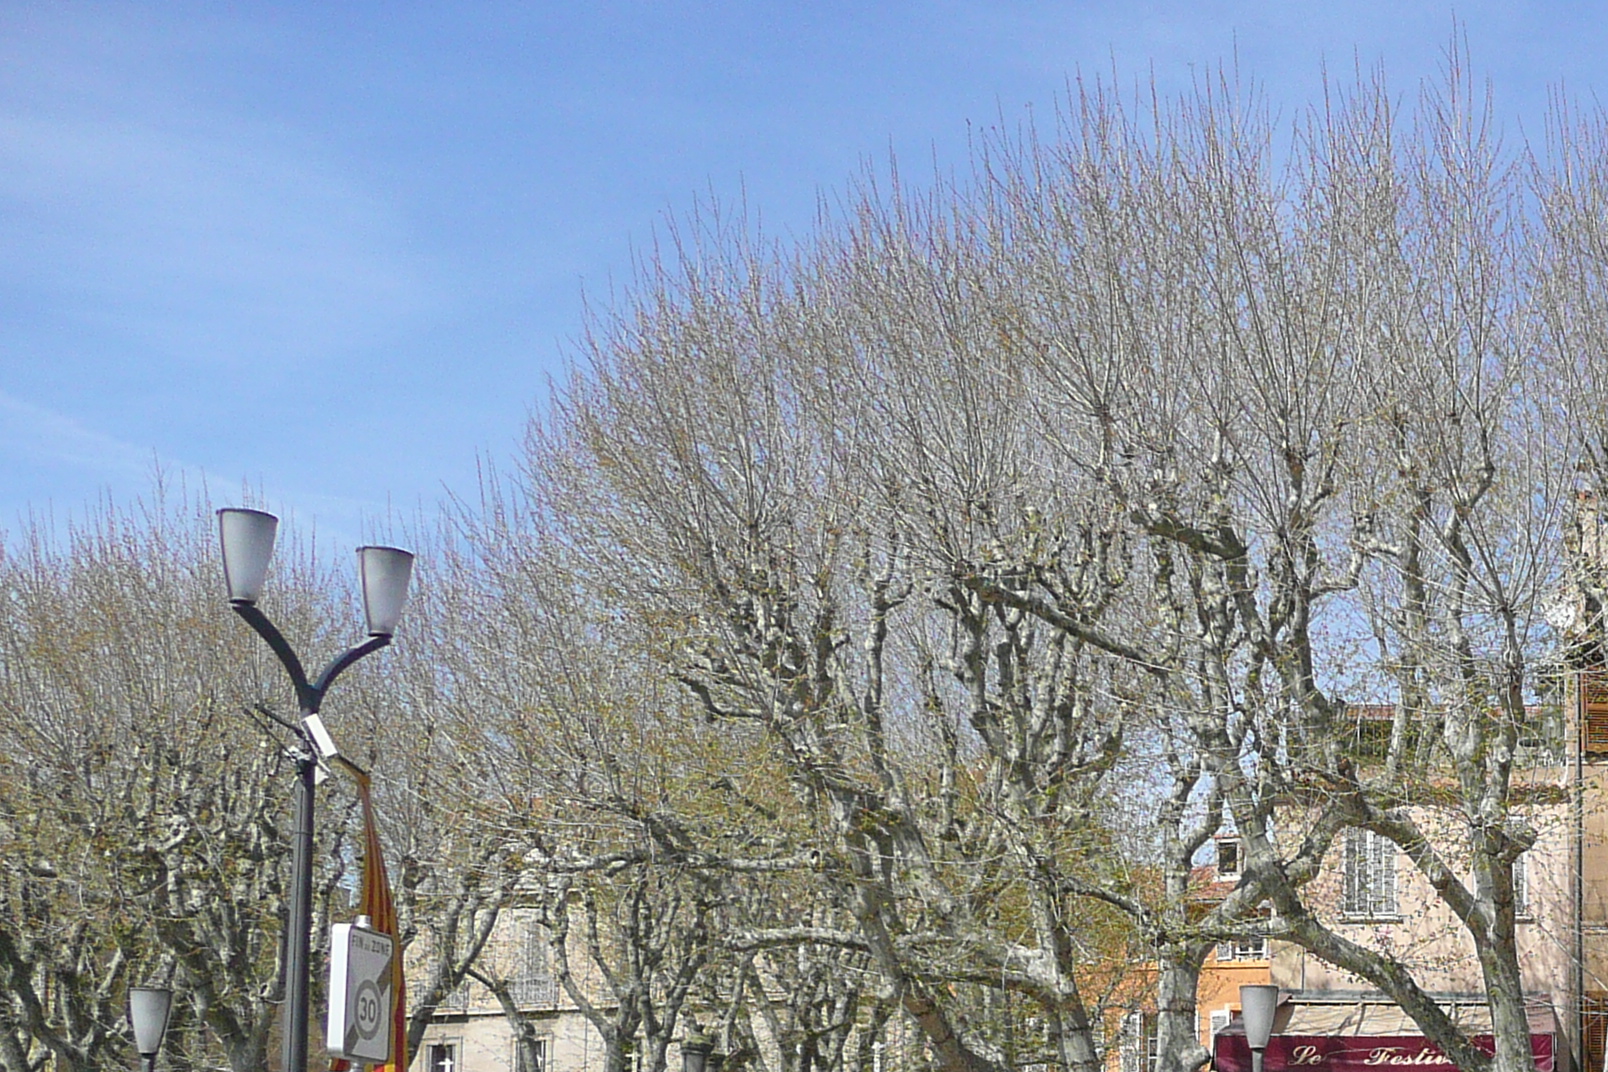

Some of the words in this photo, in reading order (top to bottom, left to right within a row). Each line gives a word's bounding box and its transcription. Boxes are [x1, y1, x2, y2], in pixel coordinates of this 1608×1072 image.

[352, 934, 364, 949] FIN
[371, 940, 391, 957] ZONE
[359, 996, 376, 1024] 30
[1287, 1044, 1322, 1067] Le
[1363, 1046, 1454, 1067] Festiv
